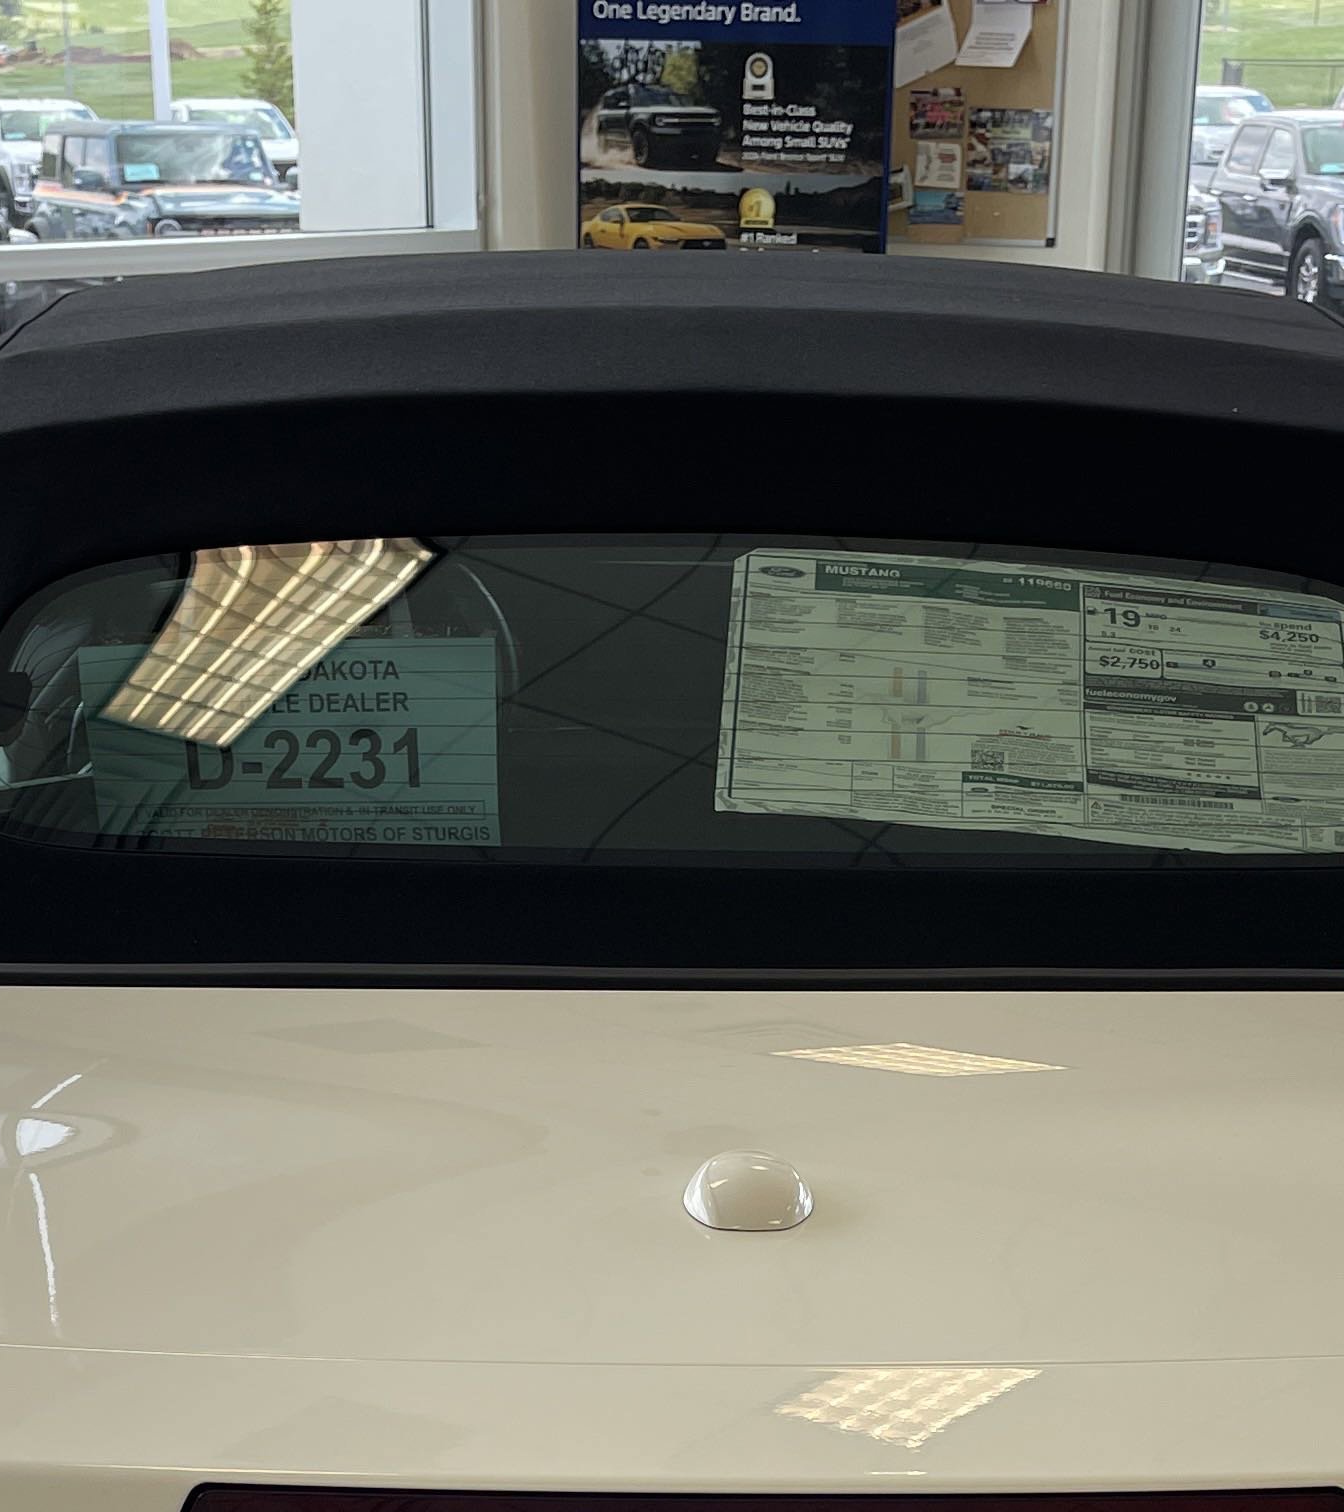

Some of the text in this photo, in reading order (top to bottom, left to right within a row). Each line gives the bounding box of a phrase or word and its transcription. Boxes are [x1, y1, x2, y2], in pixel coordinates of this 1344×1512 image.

[593, 1, 802, 25] One Legendary Brand.
[770, 120, 812, 133] Vehicle
[812, 121, 854, 135] Quality
[742, 135, 783, 150] Among
[784, 136, 817, 148] Small
[756, 232, 798, 245] Ranked
[824, 564, 901, 578] MUSTANG
[1103, 607, 1141, 627] 19
[1274, 623, 1313, 631] spend
[1259, 630, 1319, 643] $4,250
[1099, 655, 1160, 670] $2,750
[309, 692, 409, 714] DEALER
[185, 727, 420, 790] D-2231
[422, 805, 444, 815] USE
[447, 804, 476, 815] ONLY
[302, 828, 377, 842] MOTORS
[383, 828, 408, 842] OF
[413, 826, 491, 842] STURGIS
